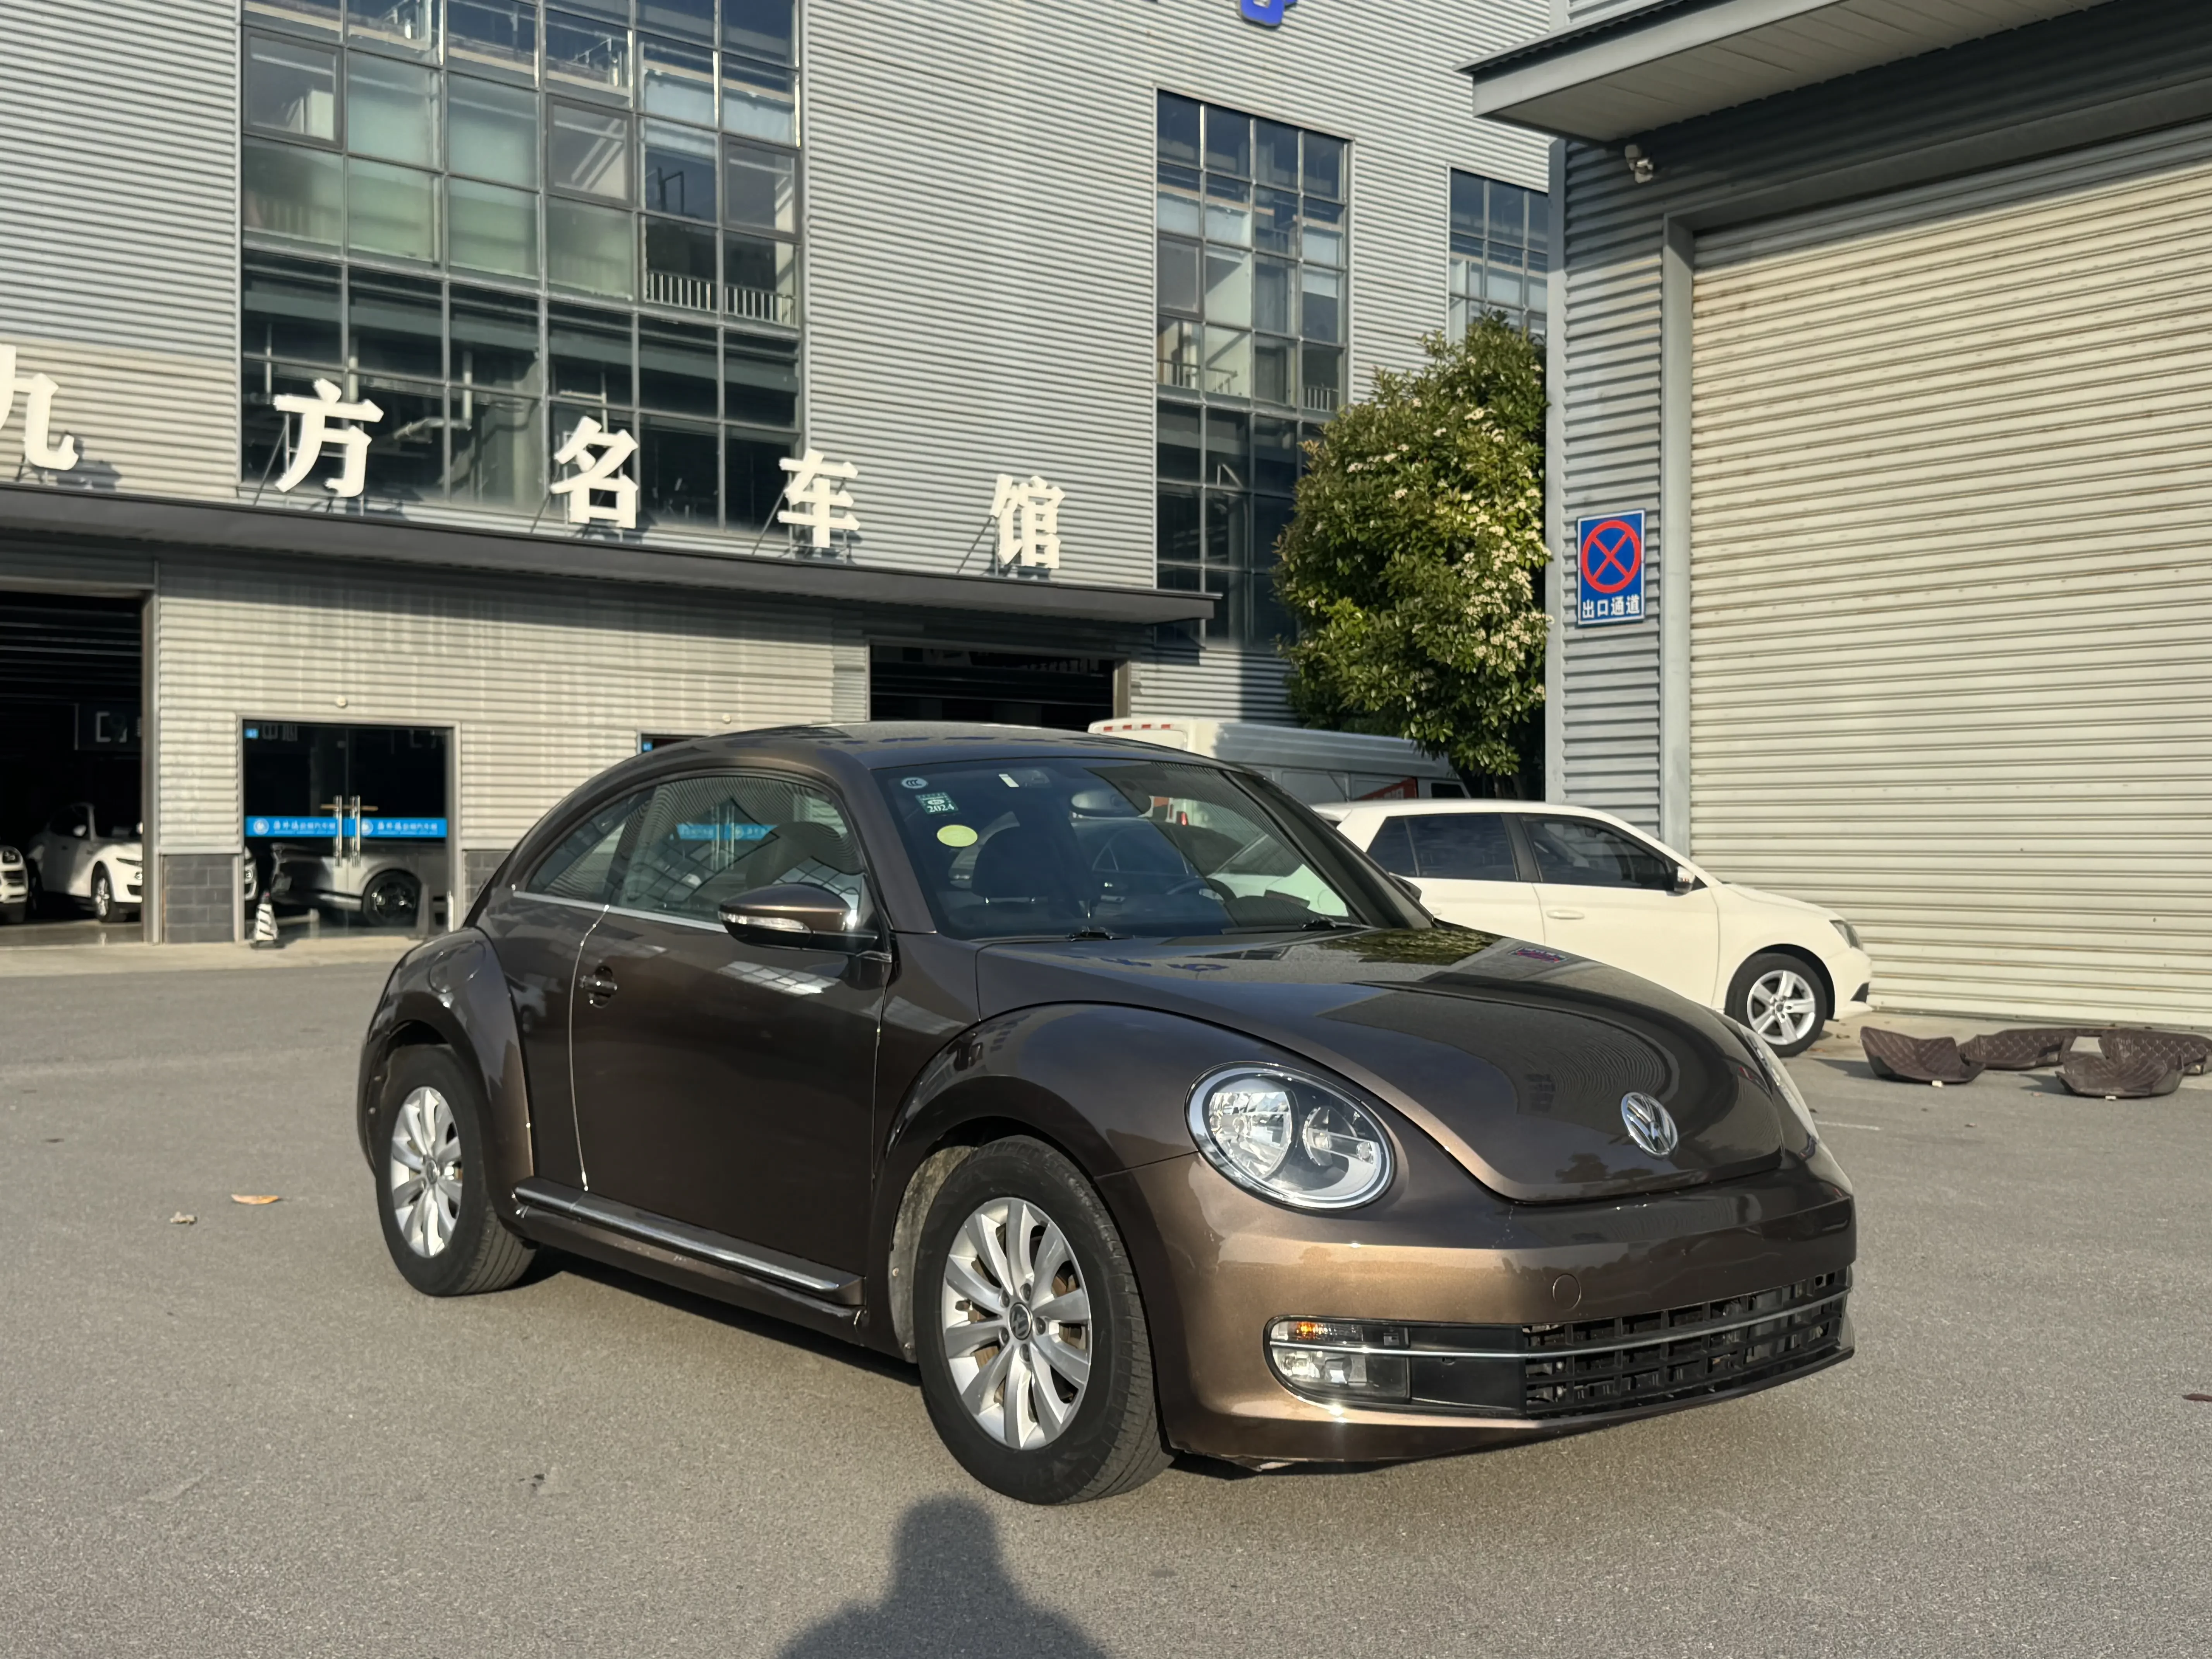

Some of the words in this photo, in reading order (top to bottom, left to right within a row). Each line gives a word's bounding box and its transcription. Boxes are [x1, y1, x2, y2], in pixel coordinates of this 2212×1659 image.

[0, 344, 1065, 569] 九方名车馆
[1582, 594, 1640, 618] 出口通道
[927, 804, 955, 813] 2024
